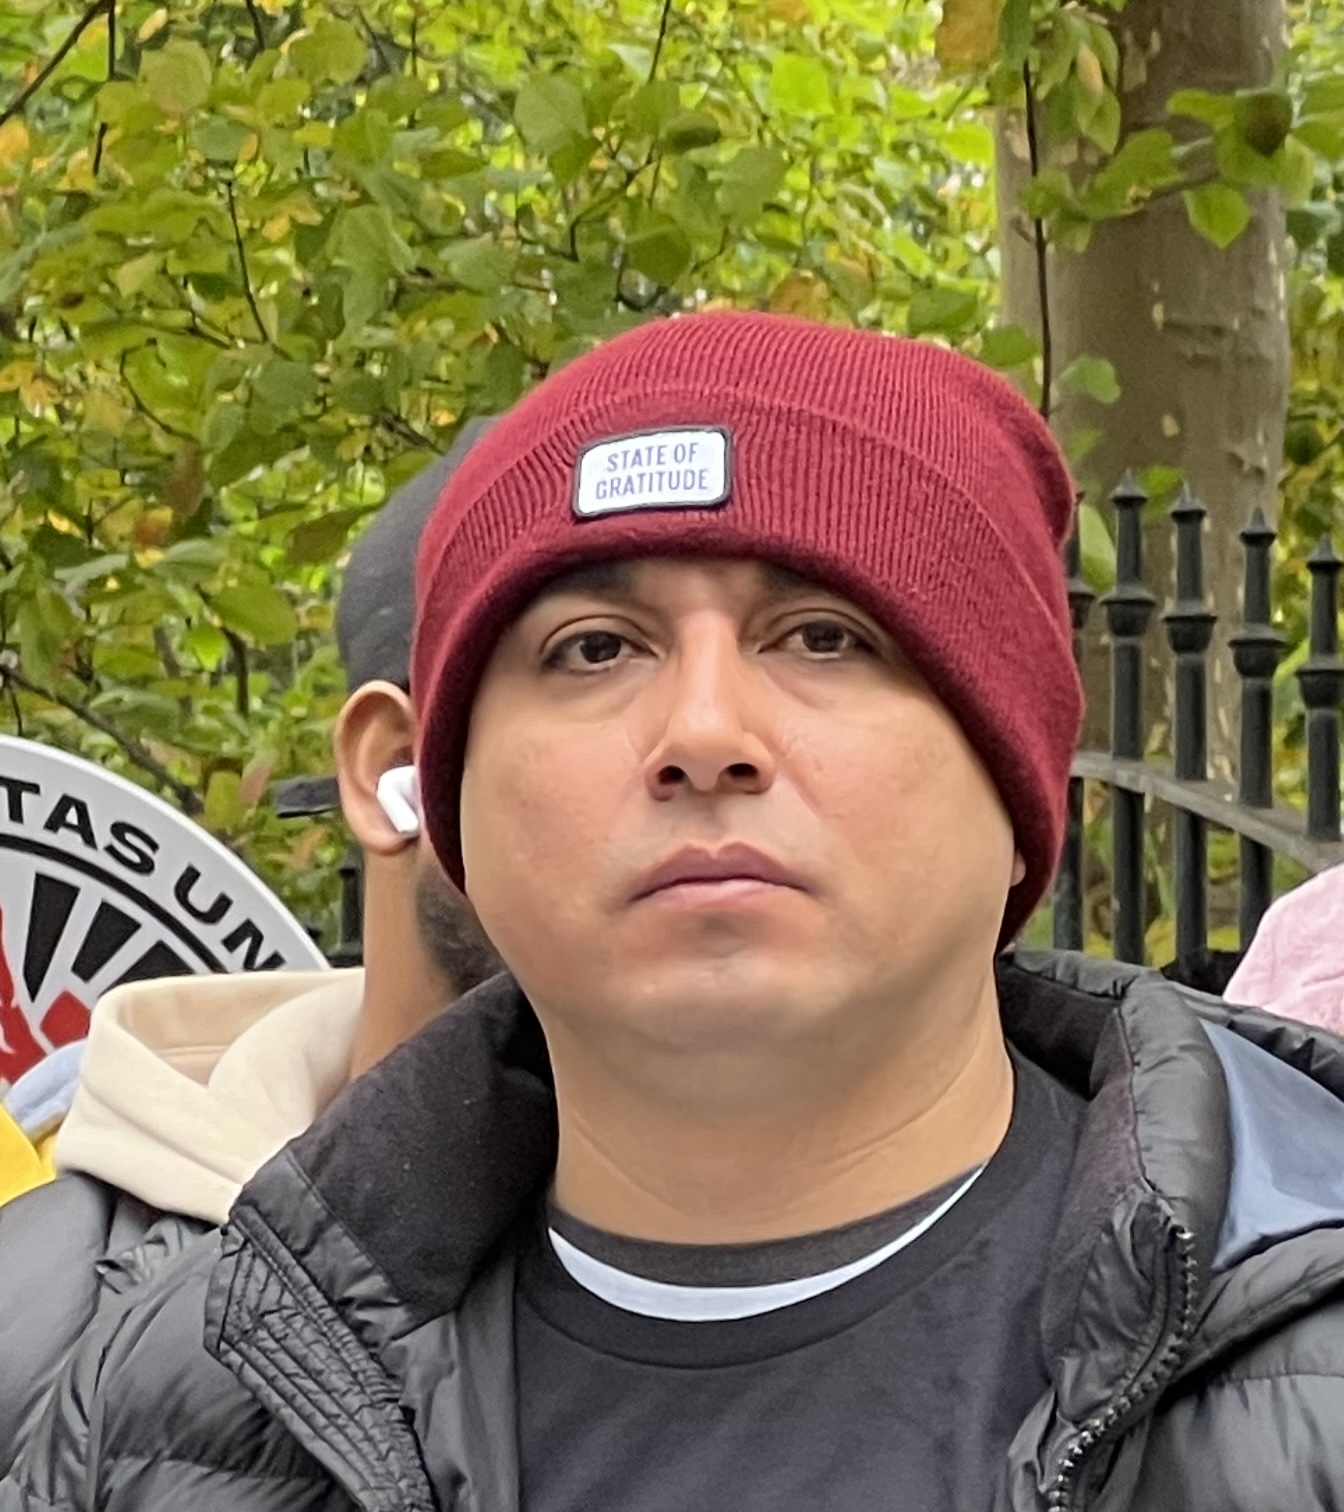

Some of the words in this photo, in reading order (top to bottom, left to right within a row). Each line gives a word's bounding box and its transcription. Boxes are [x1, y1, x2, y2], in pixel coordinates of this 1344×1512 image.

[606, 444, 668, 473] STATE
[673, 441, 699, 464] OF
[596, 468, 709, 500] GRATITUDE
